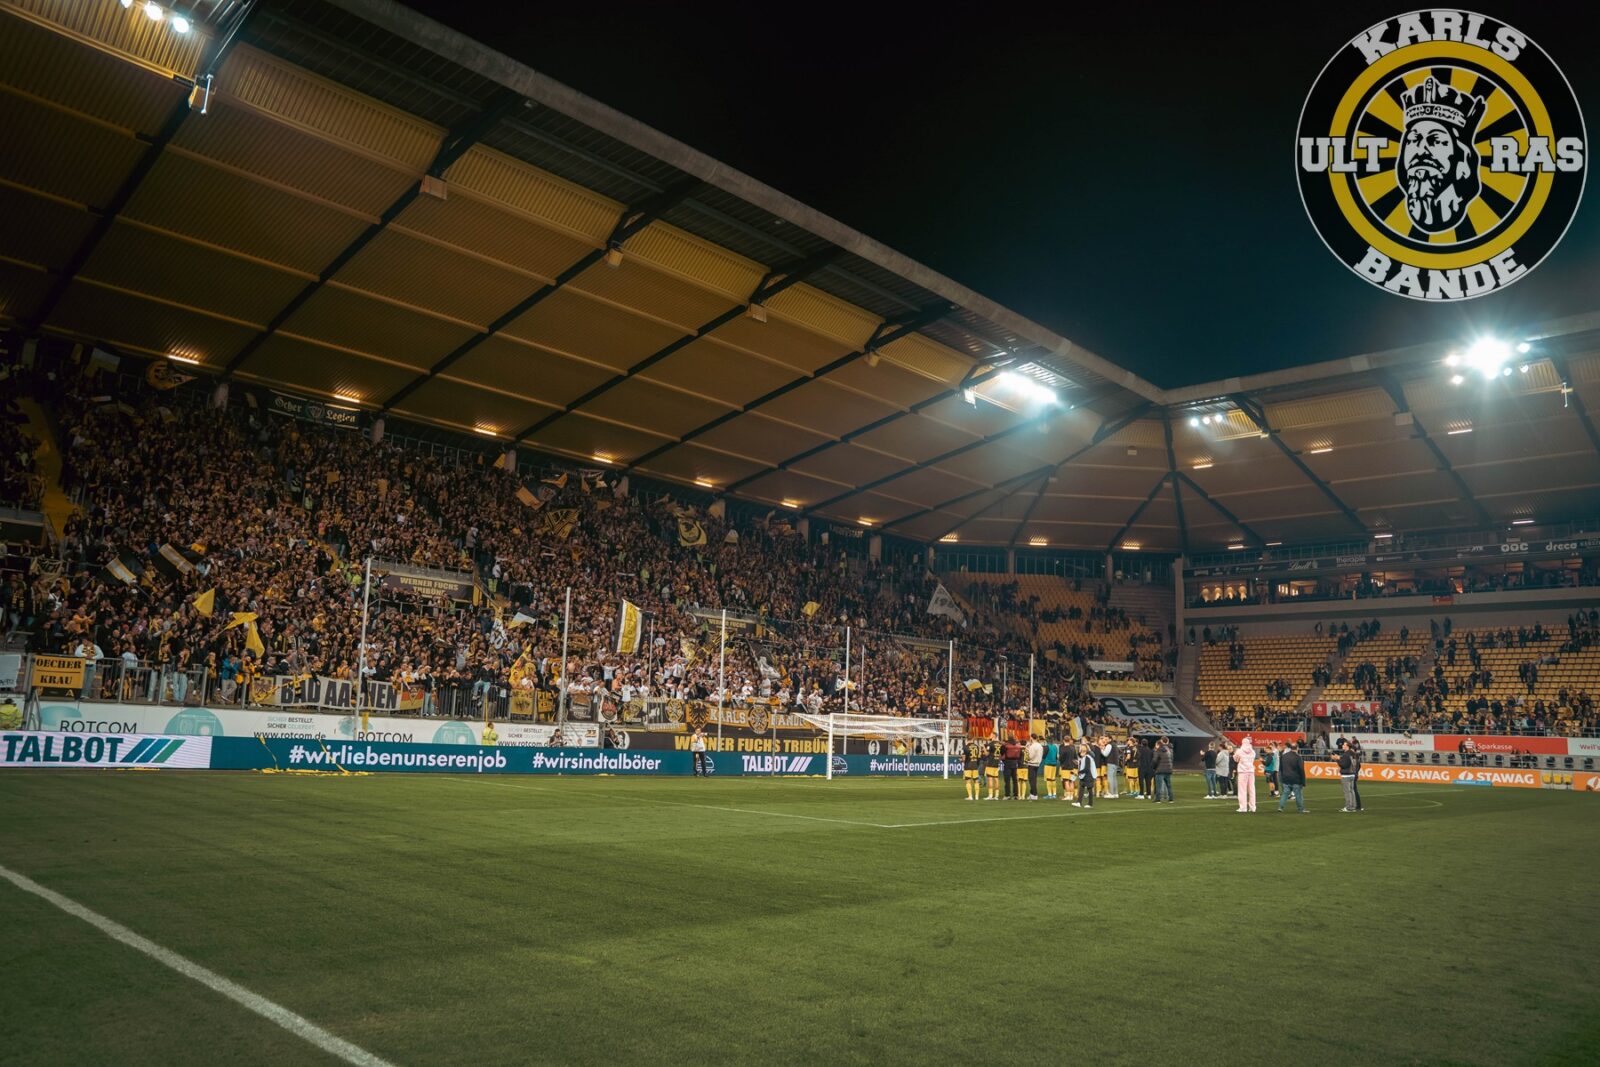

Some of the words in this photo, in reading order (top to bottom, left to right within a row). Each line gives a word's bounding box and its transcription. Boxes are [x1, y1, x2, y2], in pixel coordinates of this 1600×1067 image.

[400, 577, 433, 587] WERNER
[434, 581, 459, 591] FUCHS
[36, 658, 82, 669] OECHER
[40, 675, 72, 685] KRAU
[281, 677, 321, 704] BAD
[325, 681, 398, 709] AAHEN
[709, 708, 746, 724] KARLS
[60, 720, 137, 734] ROTCOM
[253, 731, 327, 739] www.rotcom.de
[358, 731, 413, 743] ROTCOM
[2, 735, 124, 763] TALBOT
[674, 735, 735, 751] WNER
[737, 737, 781, 753] FUCHS
[1477, 742, 1513, 751] Sparkasse
[288, 744, 508, 773] #wirliebenunserenjob
[532, 751, 662, 770] #wirsindtalböter
[742, 755, 788, 772] TALBOT
[870, 758, 965, 775] #wirliebenunsernjo
[1325, 767, 1373, 778] STAG
[1398, 769, 1450, 781] STAWAG
[1476, 772, 1535, 784] STAWAG
